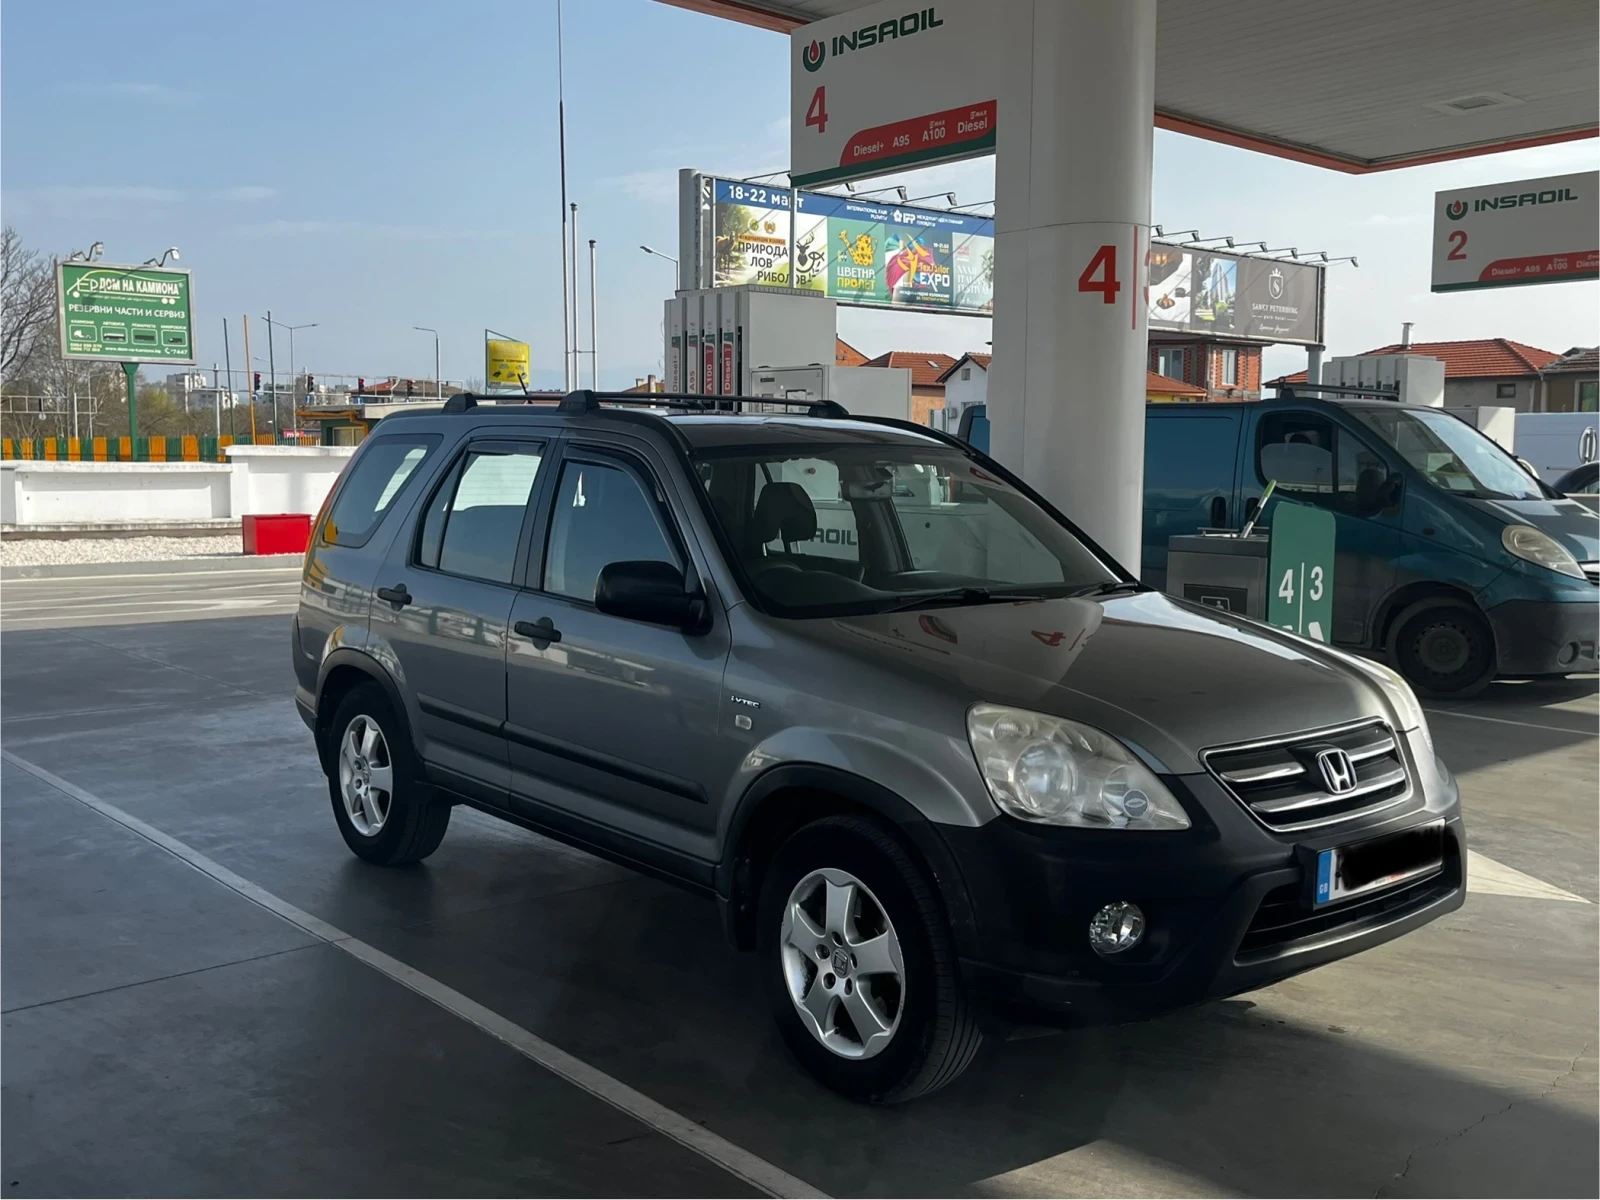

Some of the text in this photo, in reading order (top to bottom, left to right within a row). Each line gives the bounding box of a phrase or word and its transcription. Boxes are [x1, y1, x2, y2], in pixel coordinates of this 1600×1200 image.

[832, 7, 944, 57] INSAOIL
[805, 85, 829, 134] 4
[853, 117, 988, 157] Diesel+ A95 A100 Diesel
[729, 185, 767, 203] 18-22
[1474, 188, 1578, 212] INSAOIL
[738, 242, 789, 258] ПРИРОДА
[1446, 230, 1468, 261] 2
[750, 256, 773, 269] ЛОВ
[919, 262, 950, 274] TexTailor
[1524, 264, 1540, 273] A95
[1546, 262, 1568, 271] A100
[1576, 260, 1599, 269] Diese
[837, 266, 876, 279] ЦВЕТНА
[920, 271, 950, 292] EXPO
[1078, 245, 1121, 304] 4
[99, 277, 121, 292] ДОМ
[122, 280, 134, 293] НА
[136, 280, 179, 295] КАМИОНА
[837, 277, 876, 290] ПРОЛЕТ
[69, 304, 185, 319] РЕЗЕРВНИ ЧАСТИ И СЕРВИЗ
[1278, 566, 1324, 604] 4 3
[1319, 882, 1328, 894] GB
